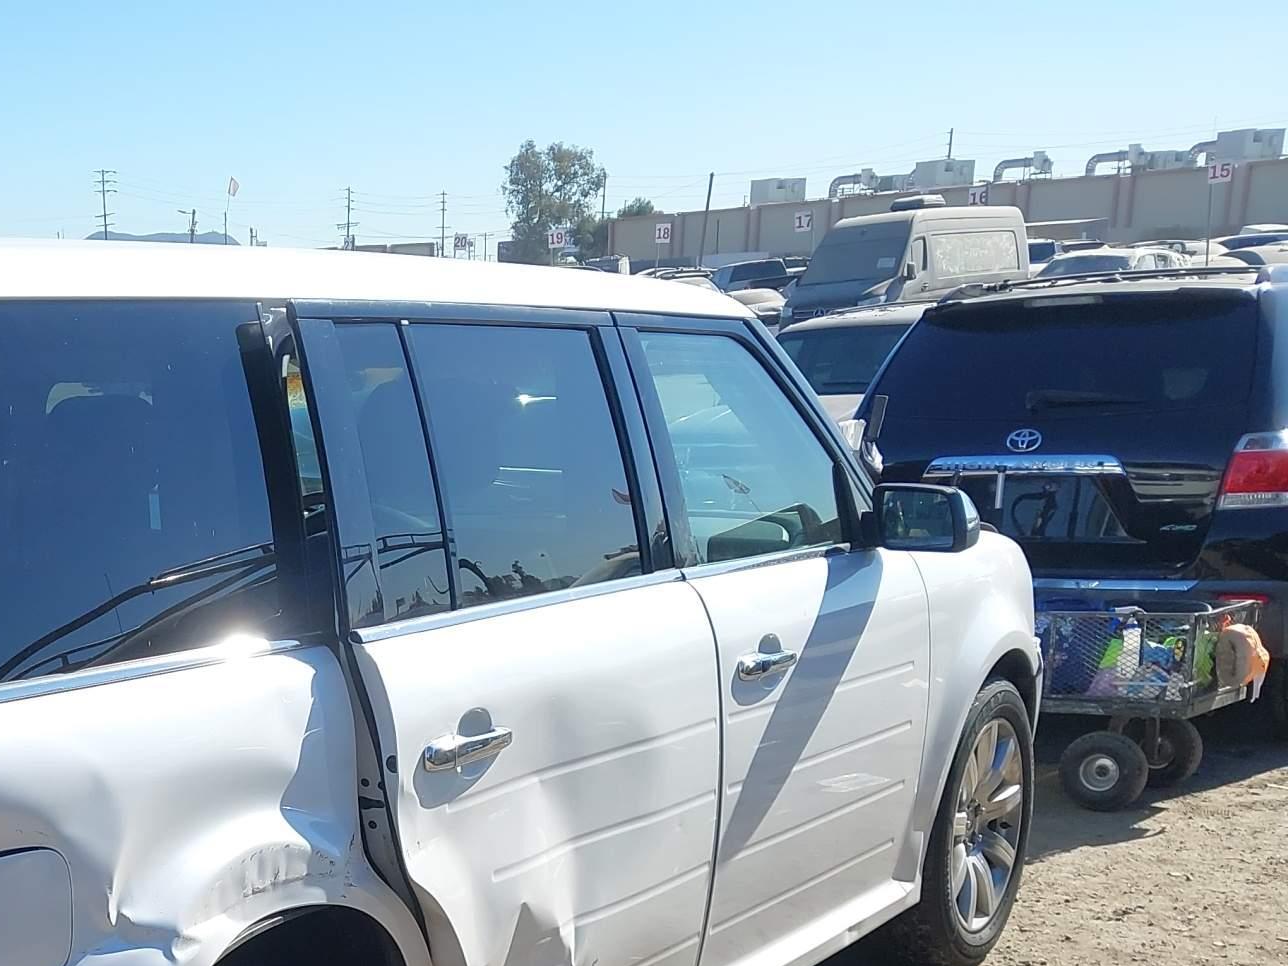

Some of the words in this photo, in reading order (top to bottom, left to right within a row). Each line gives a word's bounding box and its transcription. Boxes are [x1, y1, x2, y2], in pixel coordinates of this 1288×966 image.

[1209, 163, 1231, 179] 15
[970, 191, 987, 205] 16
[796, 214, 812, 228] 17
[550, 232, 563, 244] 19
[657, 227, 670, 240] 18
[454, 236, 467, 248] 20
